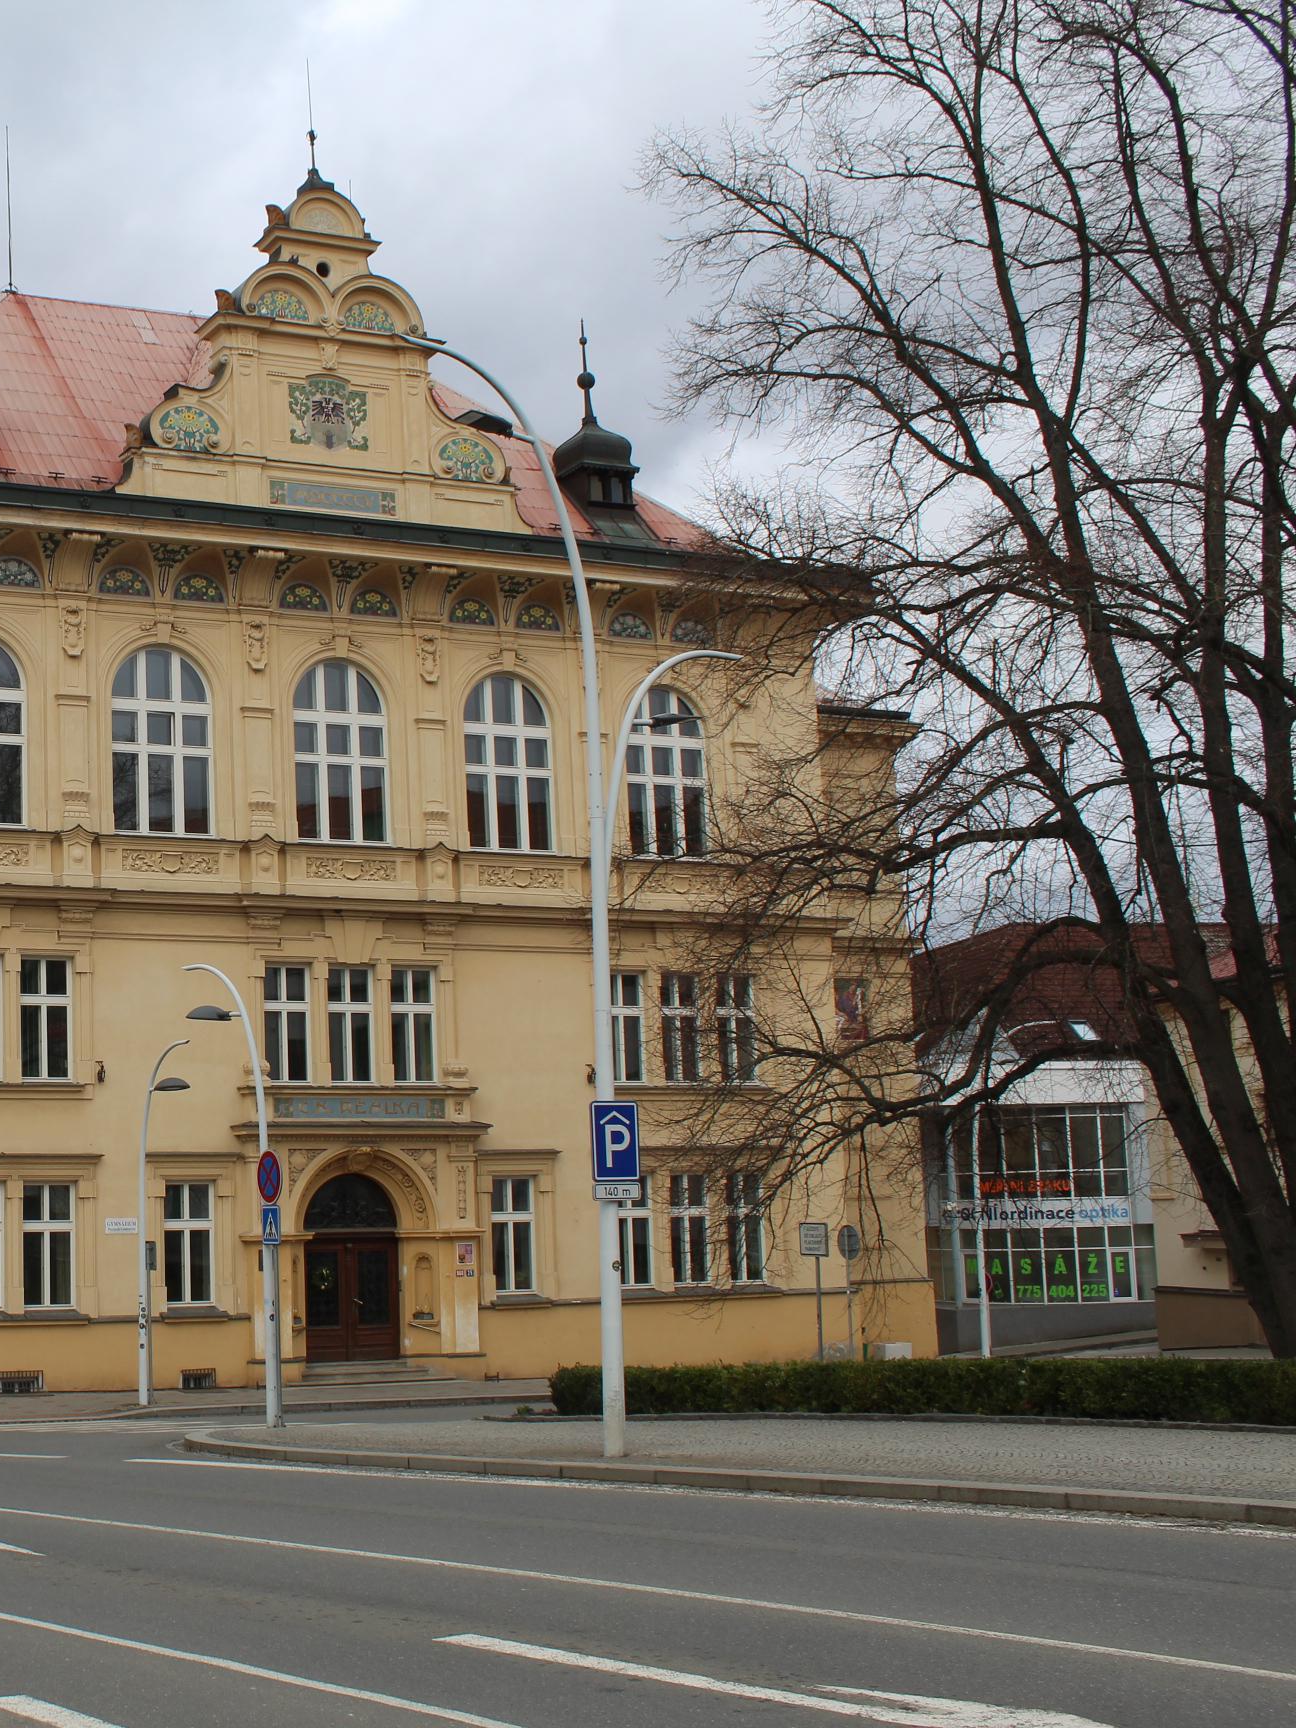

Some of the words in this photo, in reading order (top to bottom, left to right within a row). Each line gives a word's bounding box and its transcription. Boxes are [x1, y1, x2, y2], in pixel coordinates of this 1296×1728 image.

[604, 1124, 631, 1168] P
[604, 1186, 619, 1197] 140
[622, 1188, 631, 1197] m
[999, 1205, 1075, 1221] ordinace
[1078, 1203, 1129, 1222] optika
[1016, 1285, 1042, 1298] 775
[1049, 1284, 1075, 1298] 404
[1082, 1283, 1108, 1298] 225
